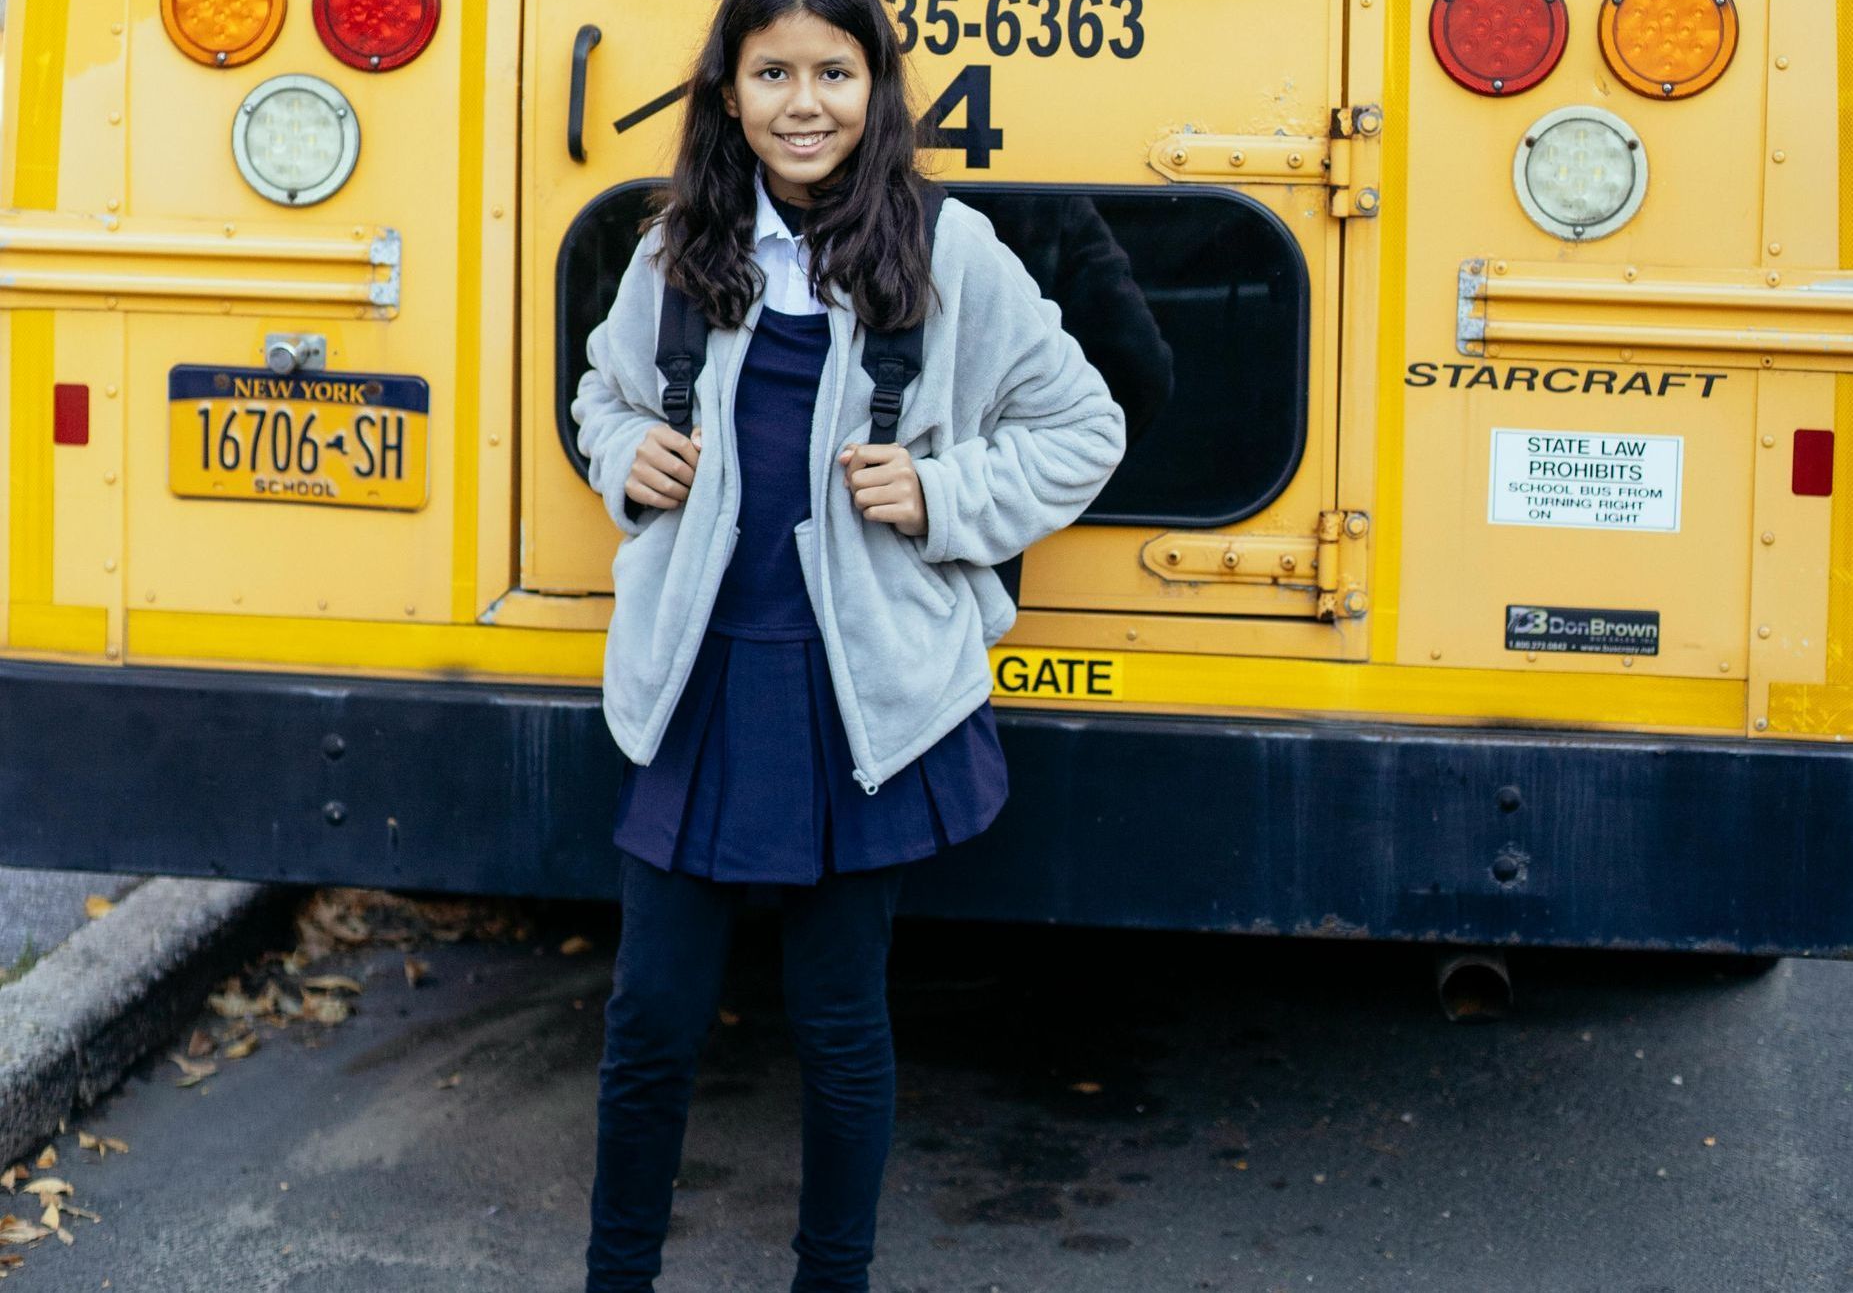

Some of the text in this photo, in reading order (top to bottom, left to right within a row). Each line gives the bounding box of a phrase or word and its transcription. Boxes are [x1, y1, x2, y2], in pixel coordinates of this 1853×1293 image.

[1404, 362, 1728, 398] STARCRAFT
[233, 378, 366, 404] NEW YORK
[198, 407, 404, 479] 16706 SH
[1527, 436, 1646, 457] STATE LAW
[1529, 460, 1643, 481] PROHIBITS
[254, 478, 336, 497] SCHOOL
[1508, 482, 1662, 498] SCHOOL BUS FROM
[1525, 496, 1645, 511] TURNING RIGHT
[1529, 509, 1640, 523] ON LIGHT
[993, 656, 1113, 695] GATE
